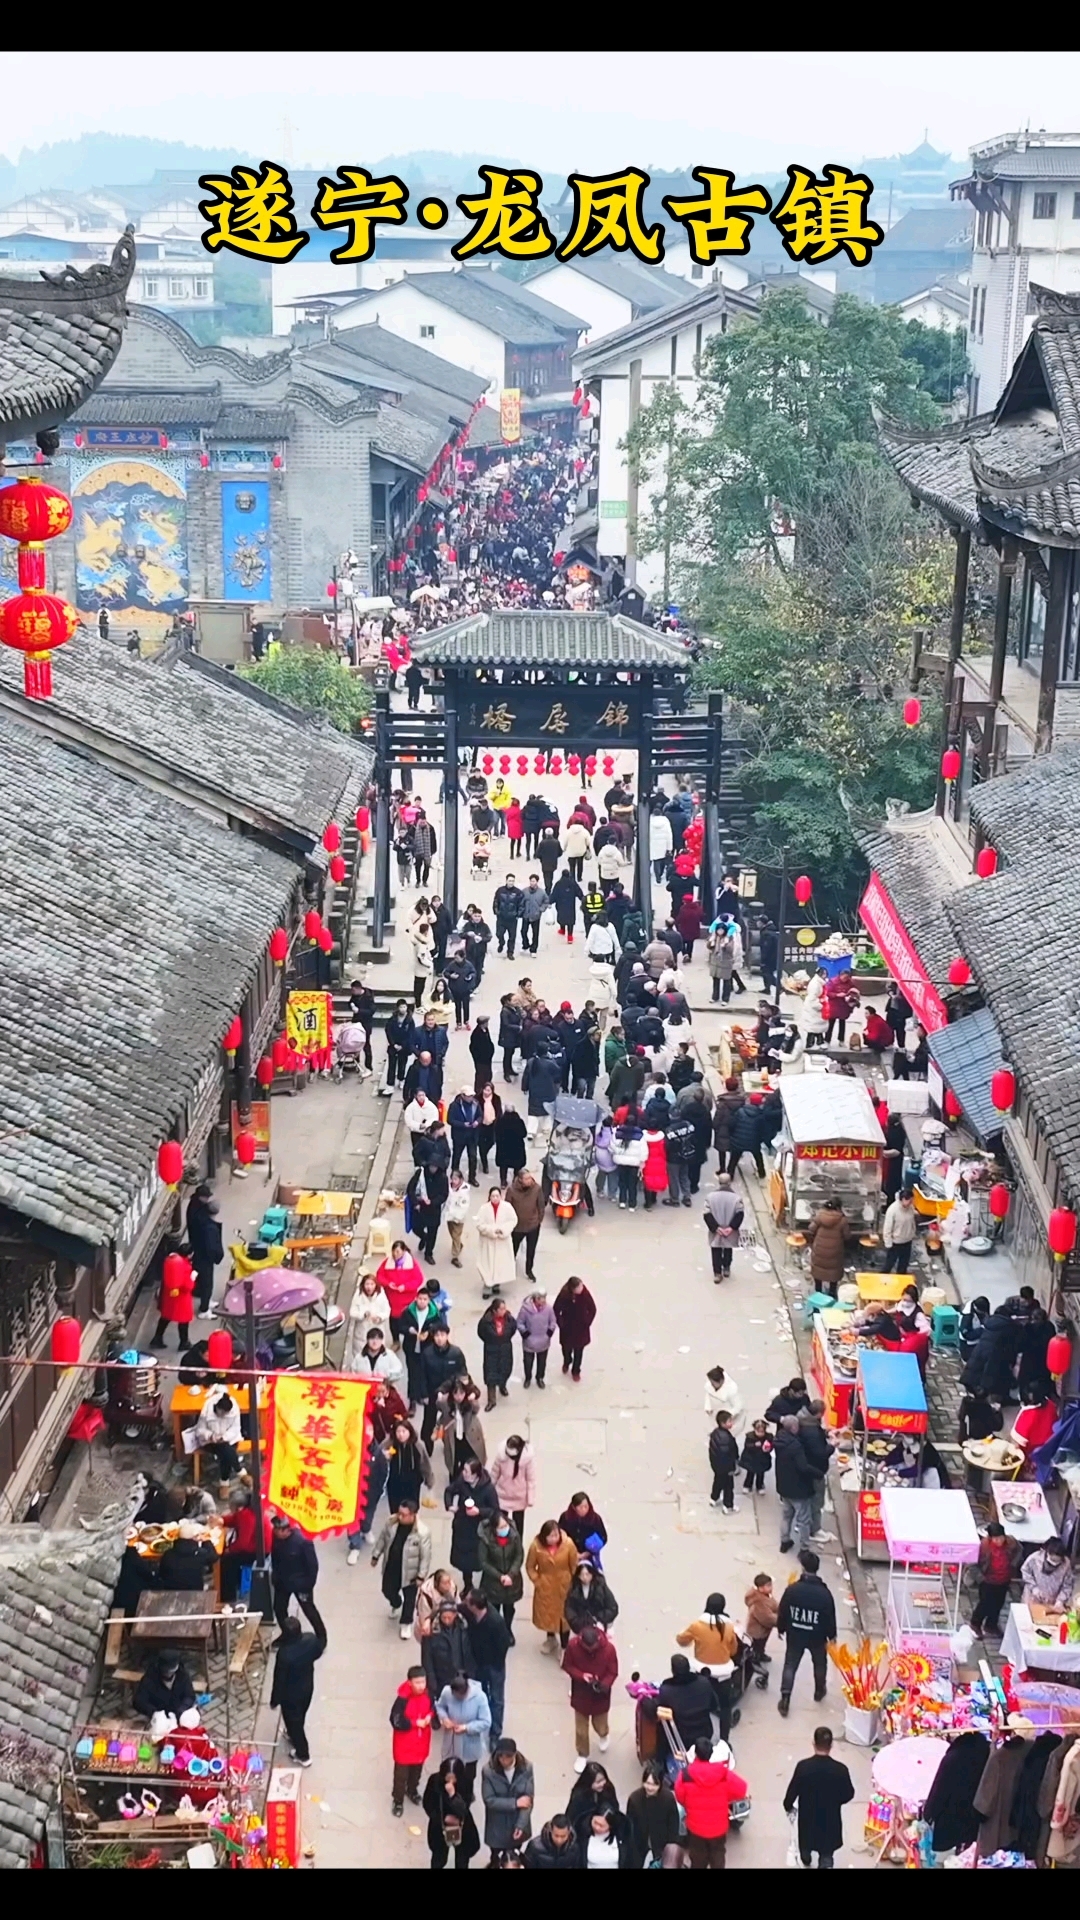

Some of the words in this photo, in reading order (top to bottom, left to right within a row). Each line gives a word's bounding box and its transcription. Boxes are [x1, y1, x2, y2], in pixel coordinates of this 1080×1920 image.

[295, 1007, 318, 1031] 酒
[800, 1144, 877, 1158] 郑记小面
